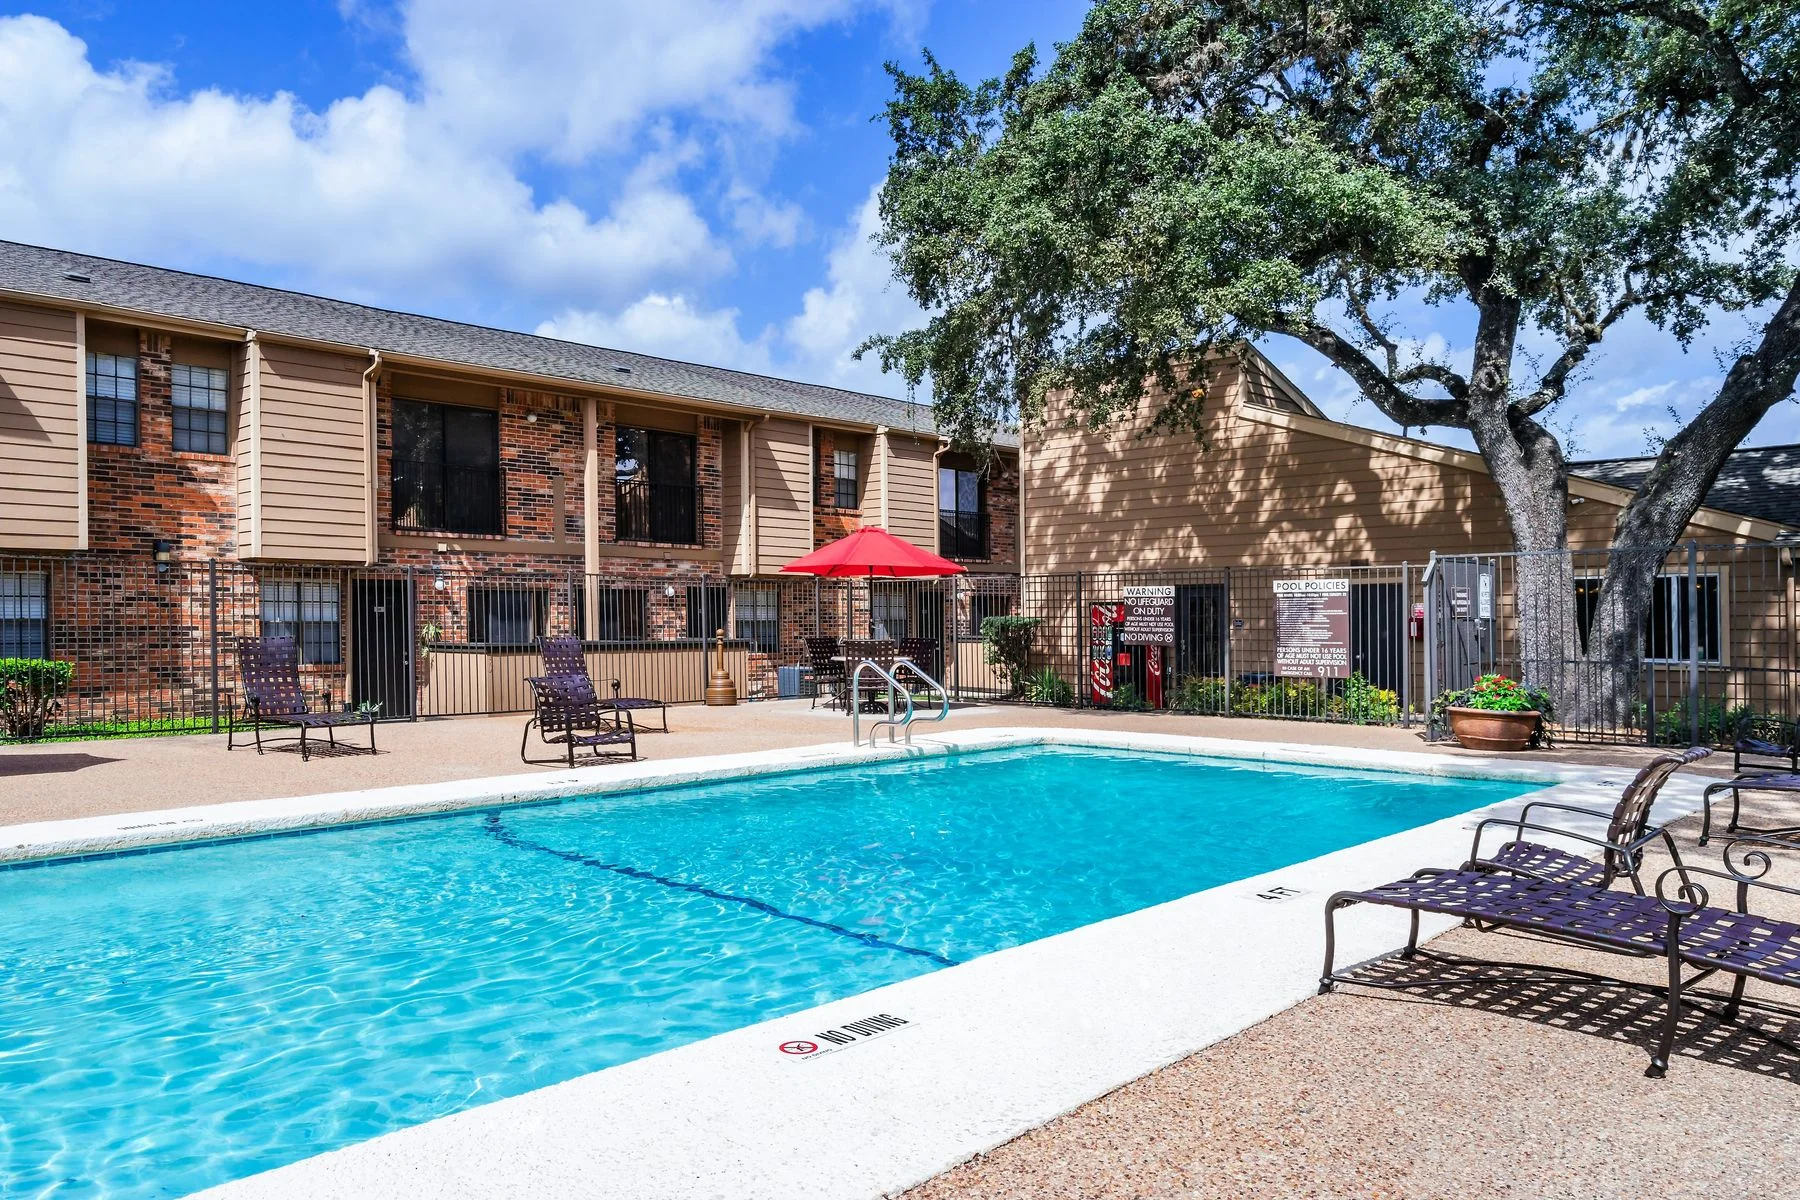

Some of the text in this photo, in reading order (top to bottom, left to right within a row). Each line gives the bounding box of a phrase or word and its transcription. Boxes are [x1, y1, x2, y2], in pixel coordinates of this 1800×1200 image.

[1276, 582, 1346, 590] POOL POLICIES
[1126, 587, 1172, 596] WARNING
[1124, 598, 1174, 606] NO LIFEGUARD
[1133, 607, 1165, 616] ON DUTY
[1124, 633, 1163, 642] NO DIVING
[1317, 666, 1338, 677] 911
[1266, 886, 1301, 897] FT
[814, 1013, 910, 1046] NO DIVING
